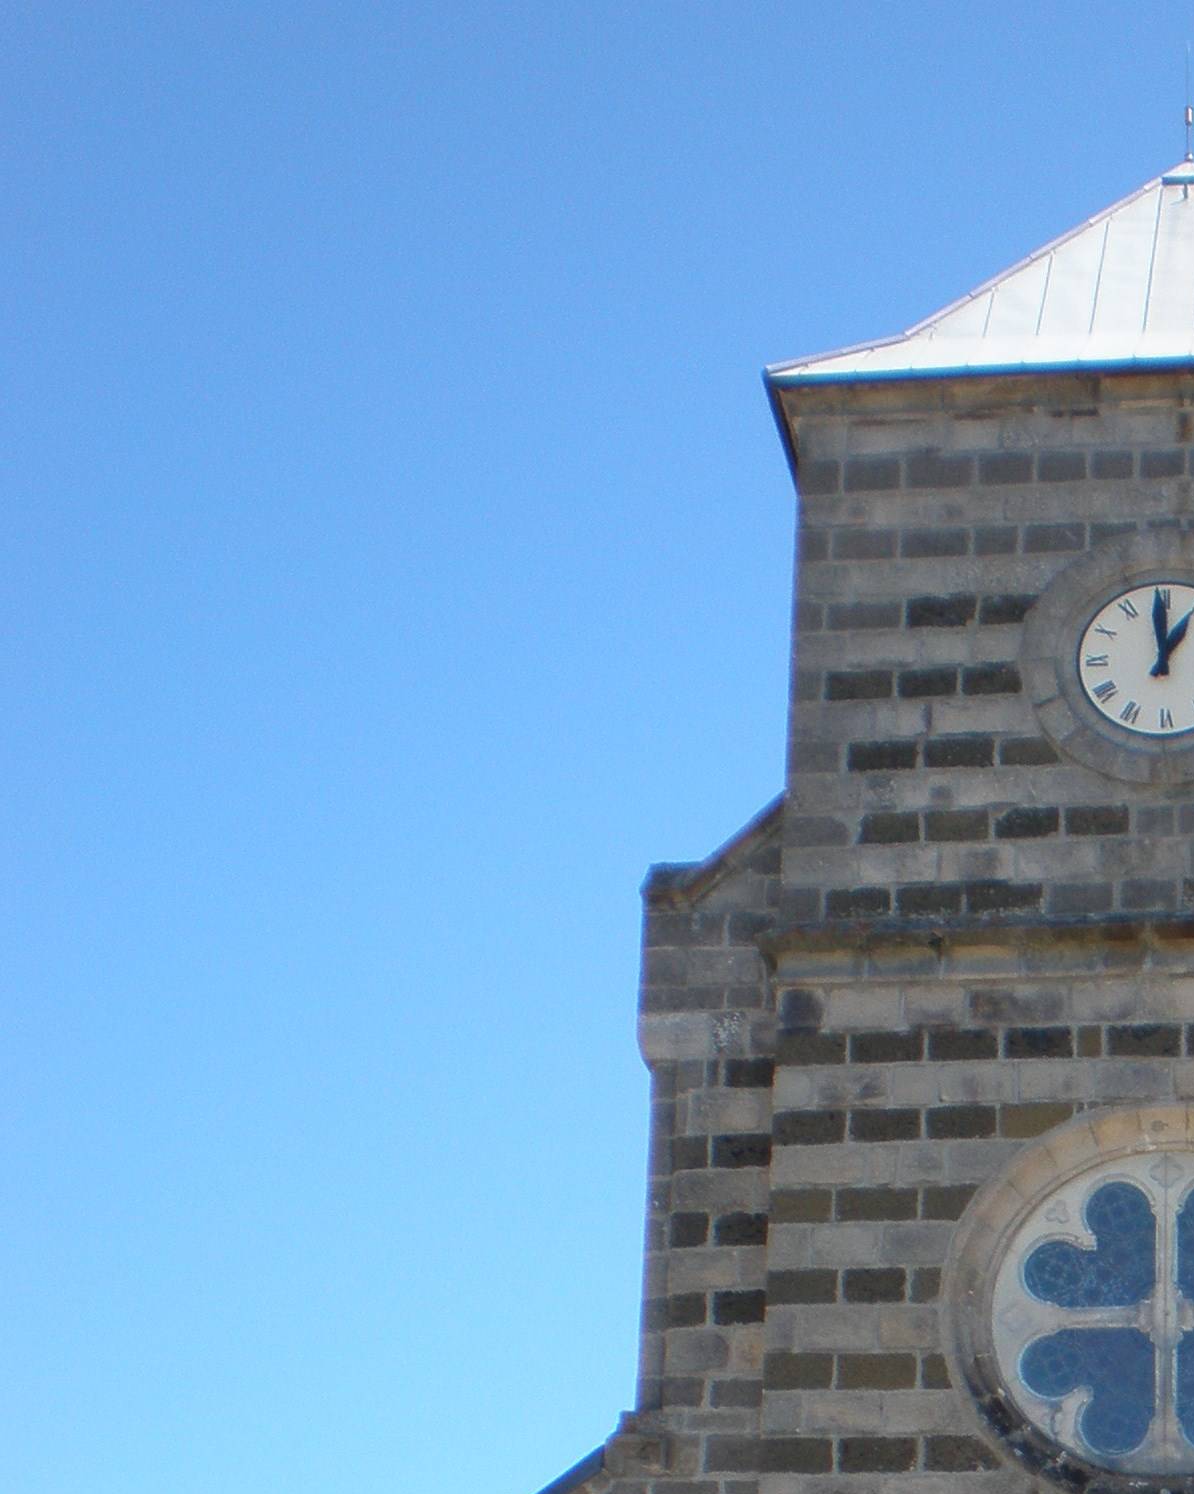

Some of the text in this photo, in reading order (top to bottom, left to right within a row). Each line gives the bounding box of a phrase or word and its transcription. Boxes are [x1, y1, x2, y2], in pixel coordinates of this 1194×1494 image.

[1118, 599, 1139, 621] XI
[1095, 624, 1117, 640] X
[1086, 655, 1109, 667] IX
[1092, 680, 1118, 704] VIII
[1119, 701, 1141, 724] VII
[1160, 708, 1174, 729] VI
